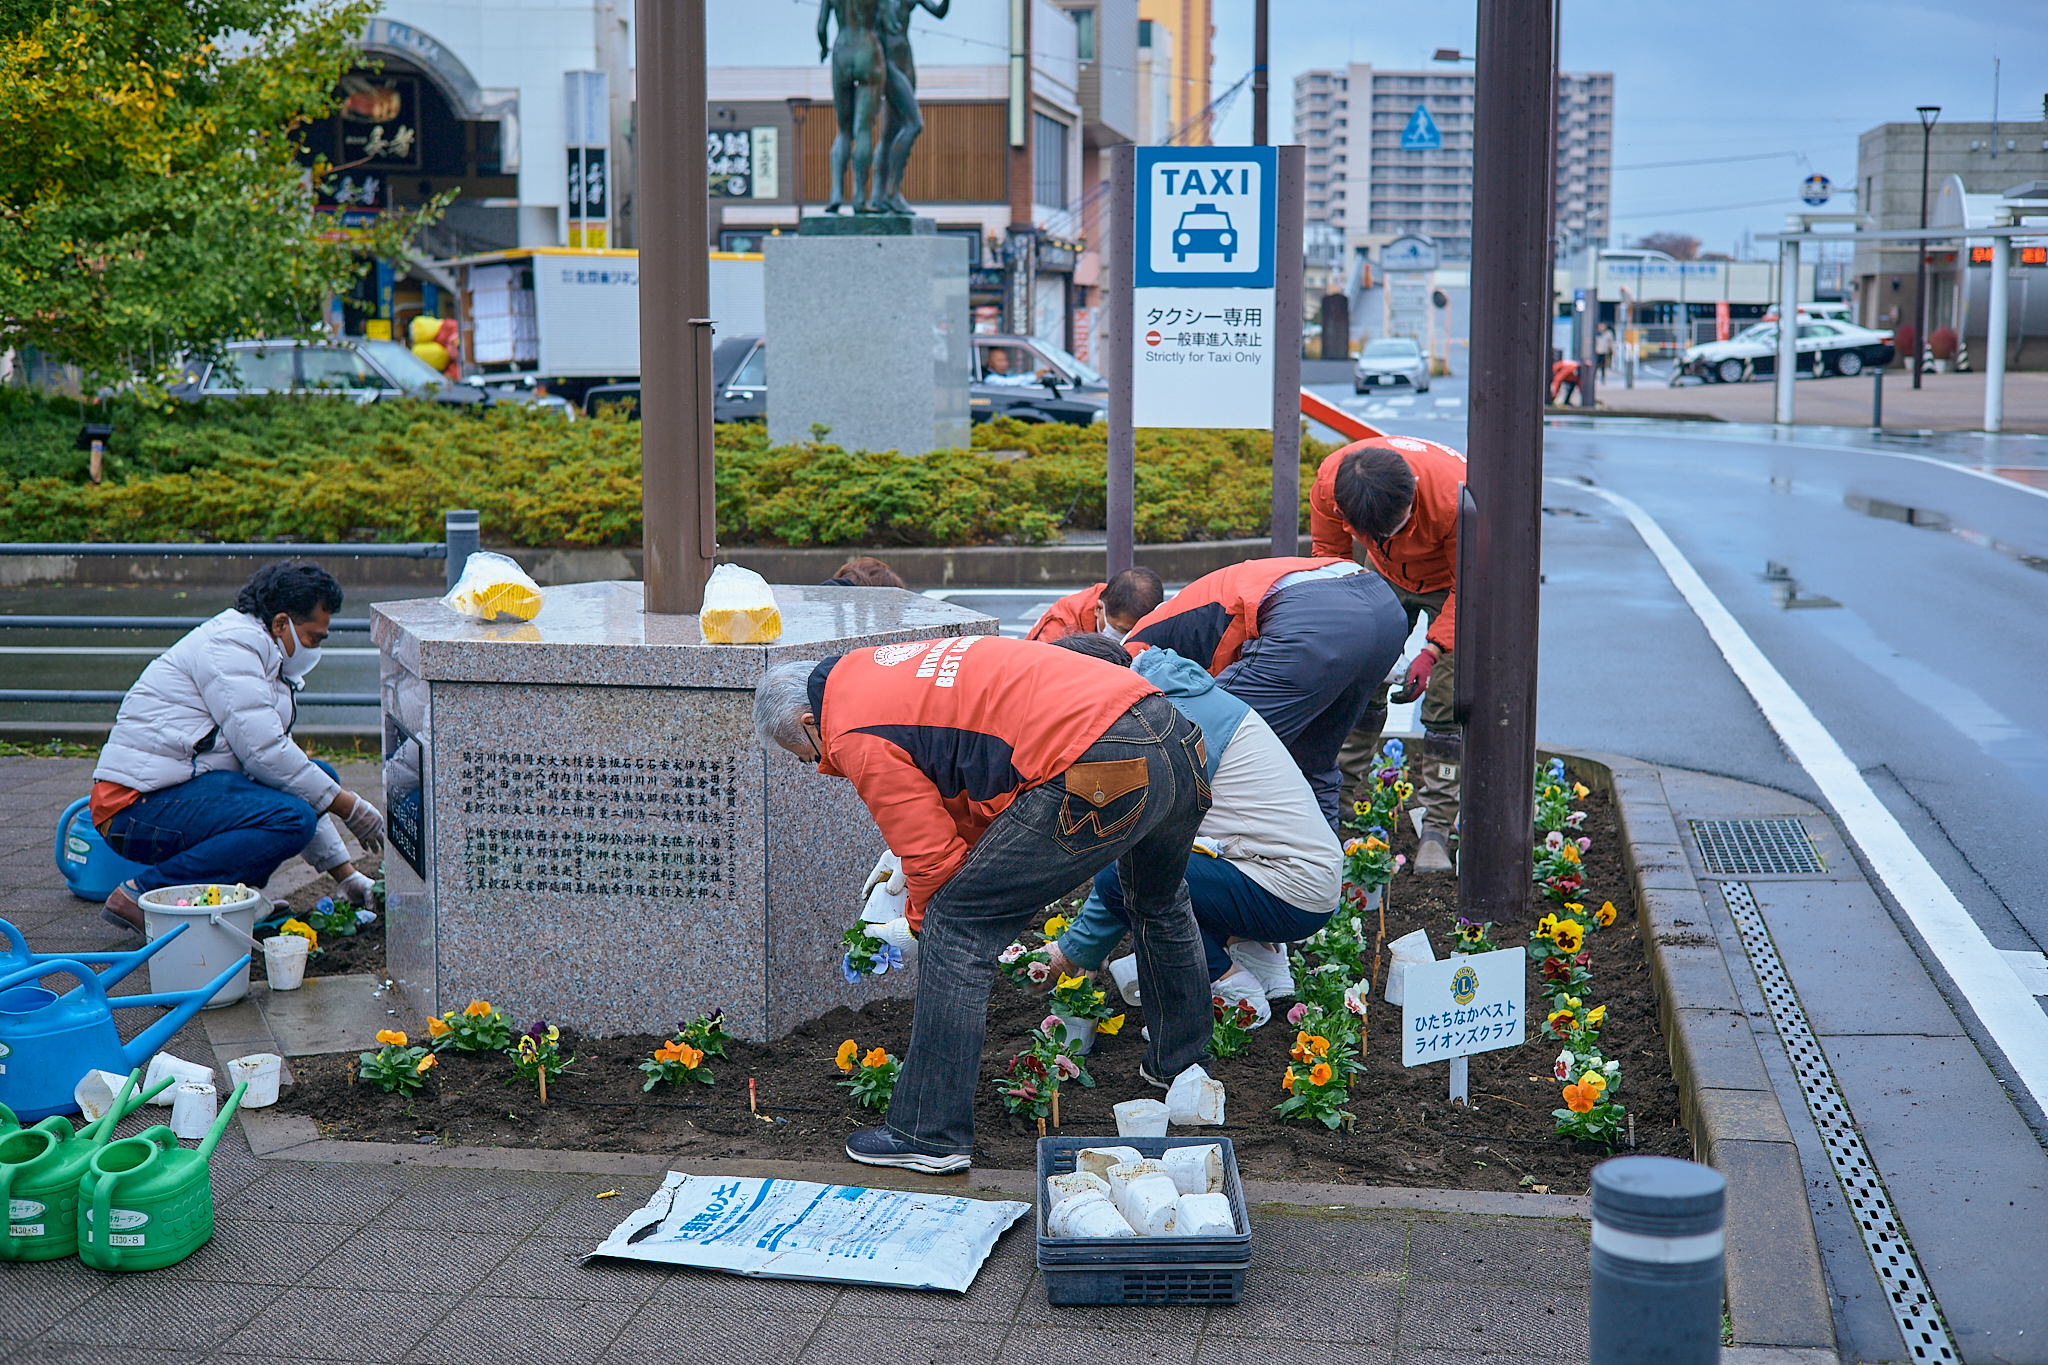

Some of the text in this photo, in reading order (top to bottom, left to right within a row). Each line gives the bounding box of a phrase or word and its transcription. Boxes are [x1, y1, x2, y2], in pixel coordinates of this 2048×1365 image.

[1160, 169, 1249, 196] TAXI
[1147, 307, 1262, 327] タクシー専用
[1075, 310, 1090, 363] KIRIN
[1163, 332, 1263, 347] 一般車進入禁止
[1145, 351, 1262, 365] Strictly for Taxi Only
[935, 654, 963, 688] BEST
[1461, 978, 1469, 993] L
[1415, 1000, 1516, 1033] ひたちなかベスト
[1415, 1018, 1517, 1055] ライオンズクラブ
[9, 1205, 38, 1213] ガーデン
